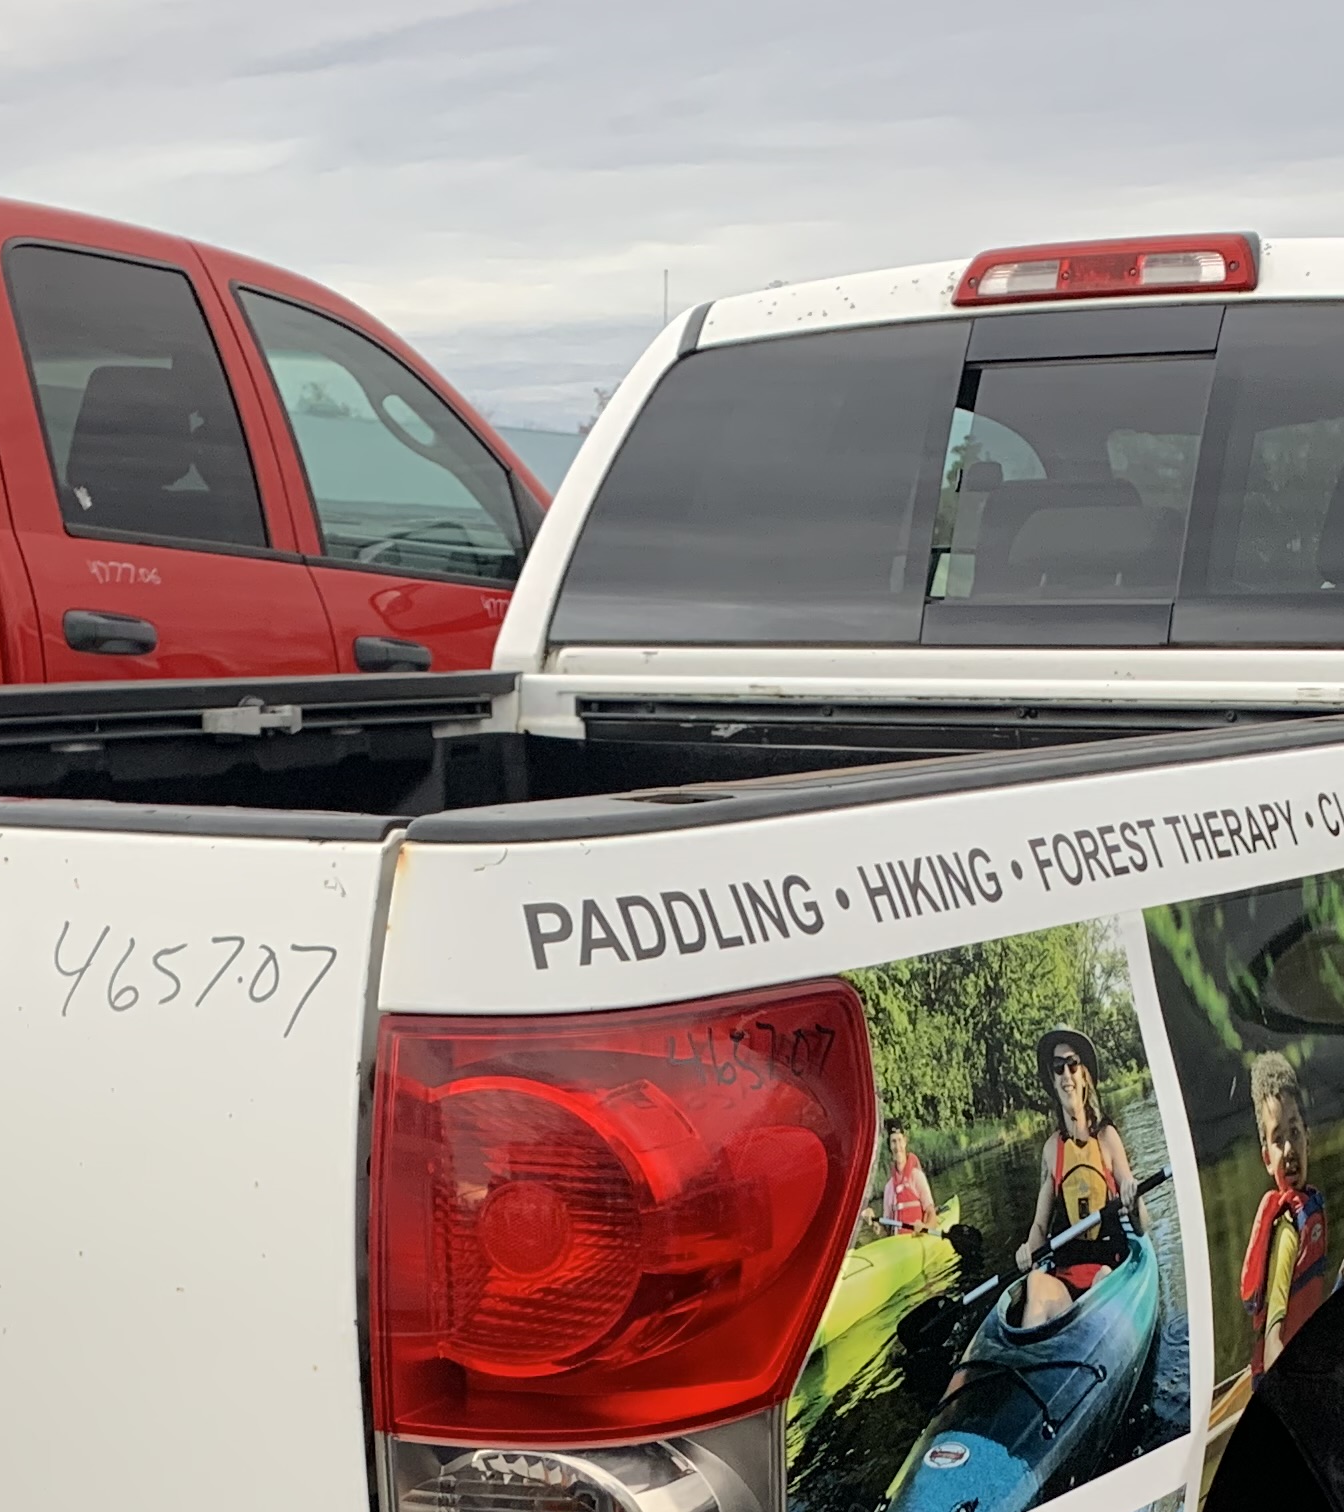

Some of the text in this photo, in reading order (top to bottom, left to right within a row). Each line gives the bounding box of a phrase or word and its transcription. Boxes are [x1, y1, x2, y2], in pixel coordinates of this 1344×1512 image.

[522, 875, 826, 971] PADDLING
[857, 847, 1003, 923] HIKING
[1027, 818, 1164, 892] FOREST
[1163, 800, 1299, 864] THERAPY
[55, 921, 338, 1038] 4657.07
